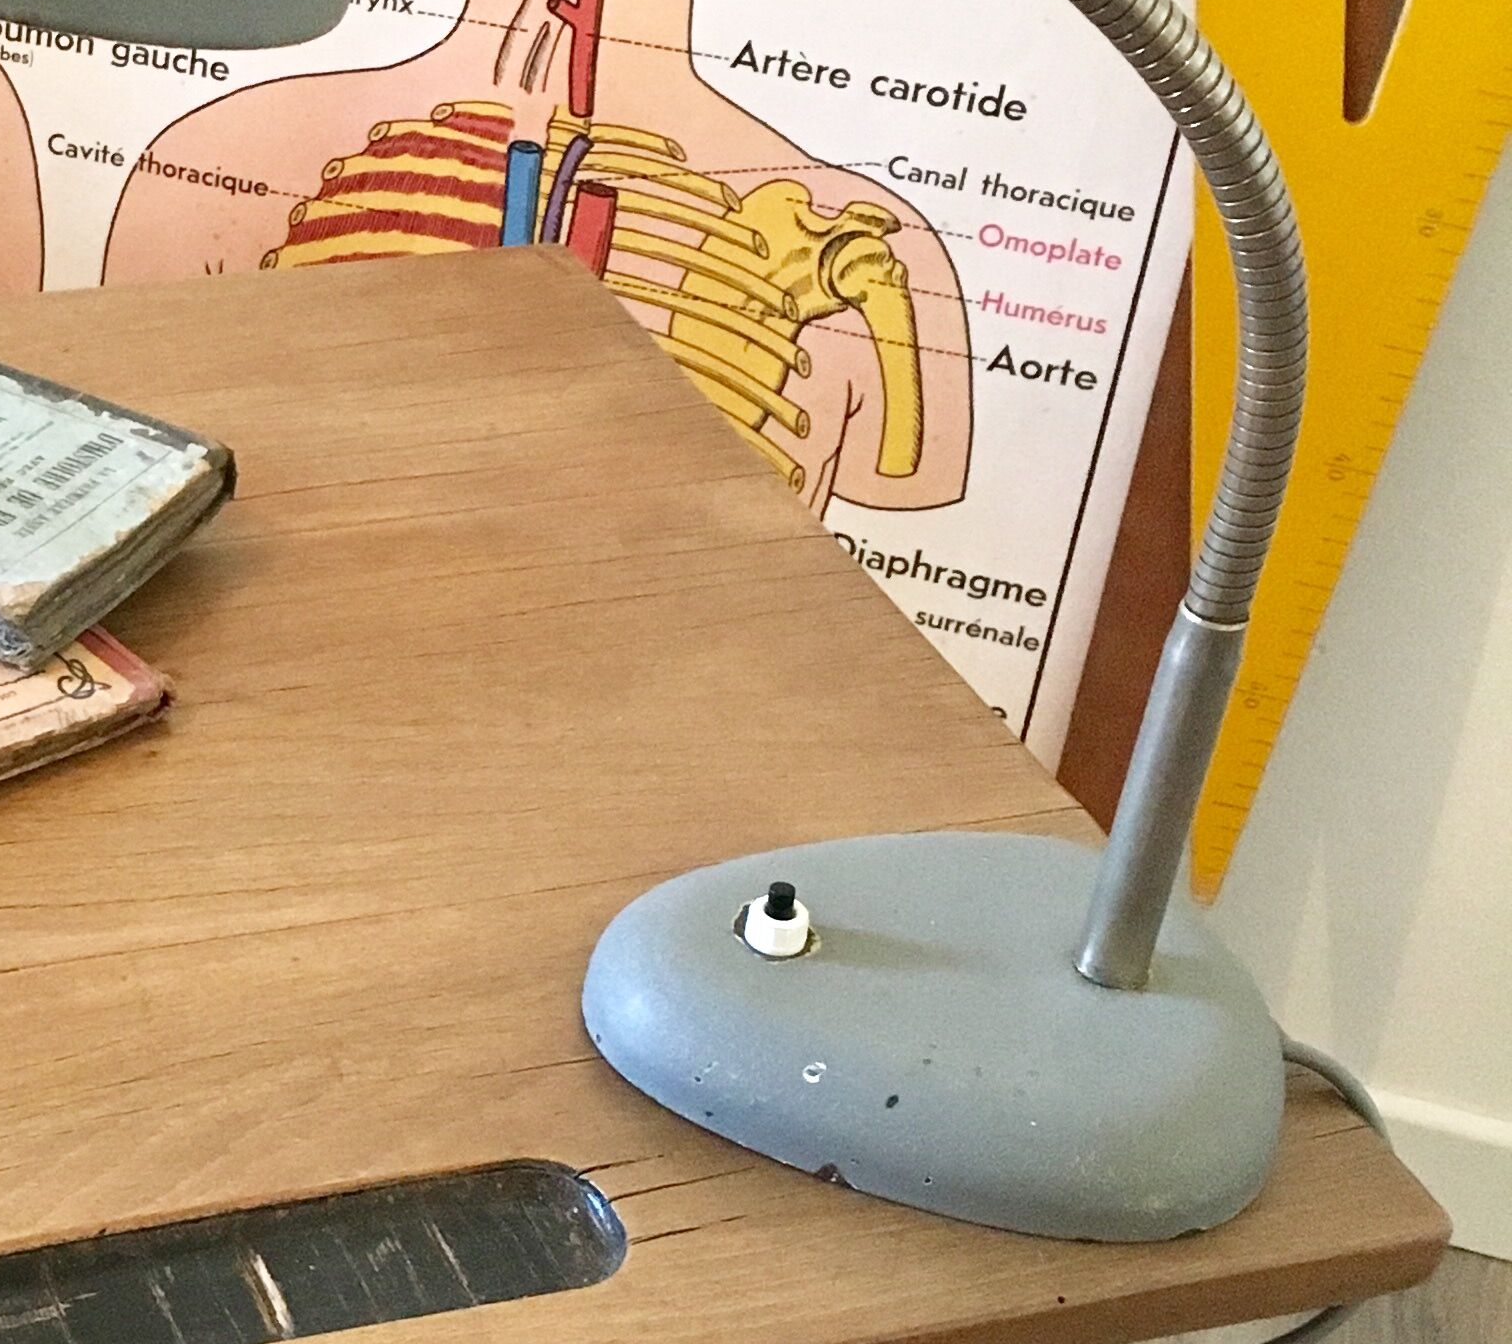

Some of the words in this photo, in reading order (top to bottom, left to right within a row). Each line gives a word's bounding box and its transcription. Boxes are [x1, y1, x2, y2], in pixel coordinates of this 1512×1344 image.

[110, 42, 230, 82] gauche
[730, 39, 852, 89] Artère
[870, 74, 1028, 122] carotide
[48, 133, 125, 168] Cavité
[138, 150, 269, 199] thoracique
[888, 156, 967, 191] Canal
[981, 173, 1136, 222] thoracique
[978, 223, 1123, 270] Omoplate
[981, 290, 1108, 334] Humérus
[986, 344, 1098, 392] Aorte
[6, 487, 42, 511] DE
[914, 609, 1041, 652] surrénale
